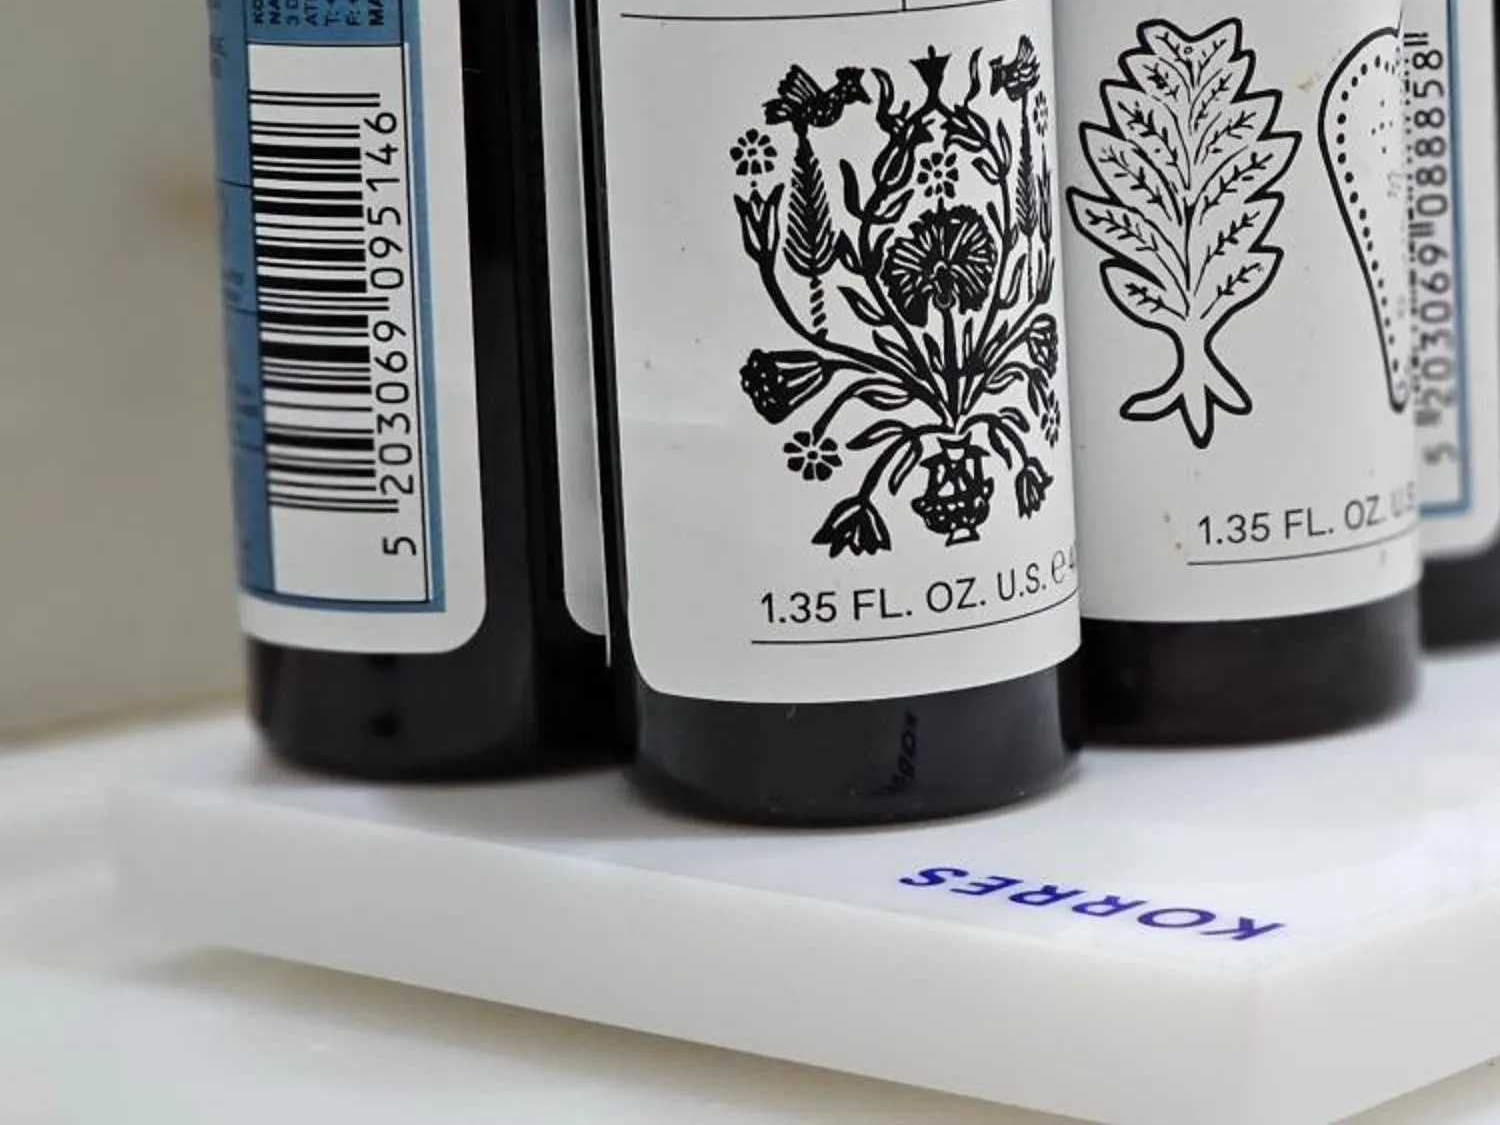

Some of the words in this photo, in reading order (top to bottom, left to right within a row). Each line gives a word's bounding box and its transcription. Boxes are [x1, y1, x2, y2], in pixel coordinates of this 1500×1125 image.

[1412, 49, 1448, 217] 088858
[363, 112, 404, 289] 095146
[373, 320, 414, 495] 203069
[382, 536, 416, 556] 5
[1197, 512, 1271, 546] 1.35
[1285, 508, 1334, 541] FL.
[761, 590, 837, 624] 1.35
[853, 587, 912, 621] FL.
[926, 576, 986, 615] OZ.
[997, 562, 1047, 601] U.S.
[899, 866, 1287, 941] KORRES
